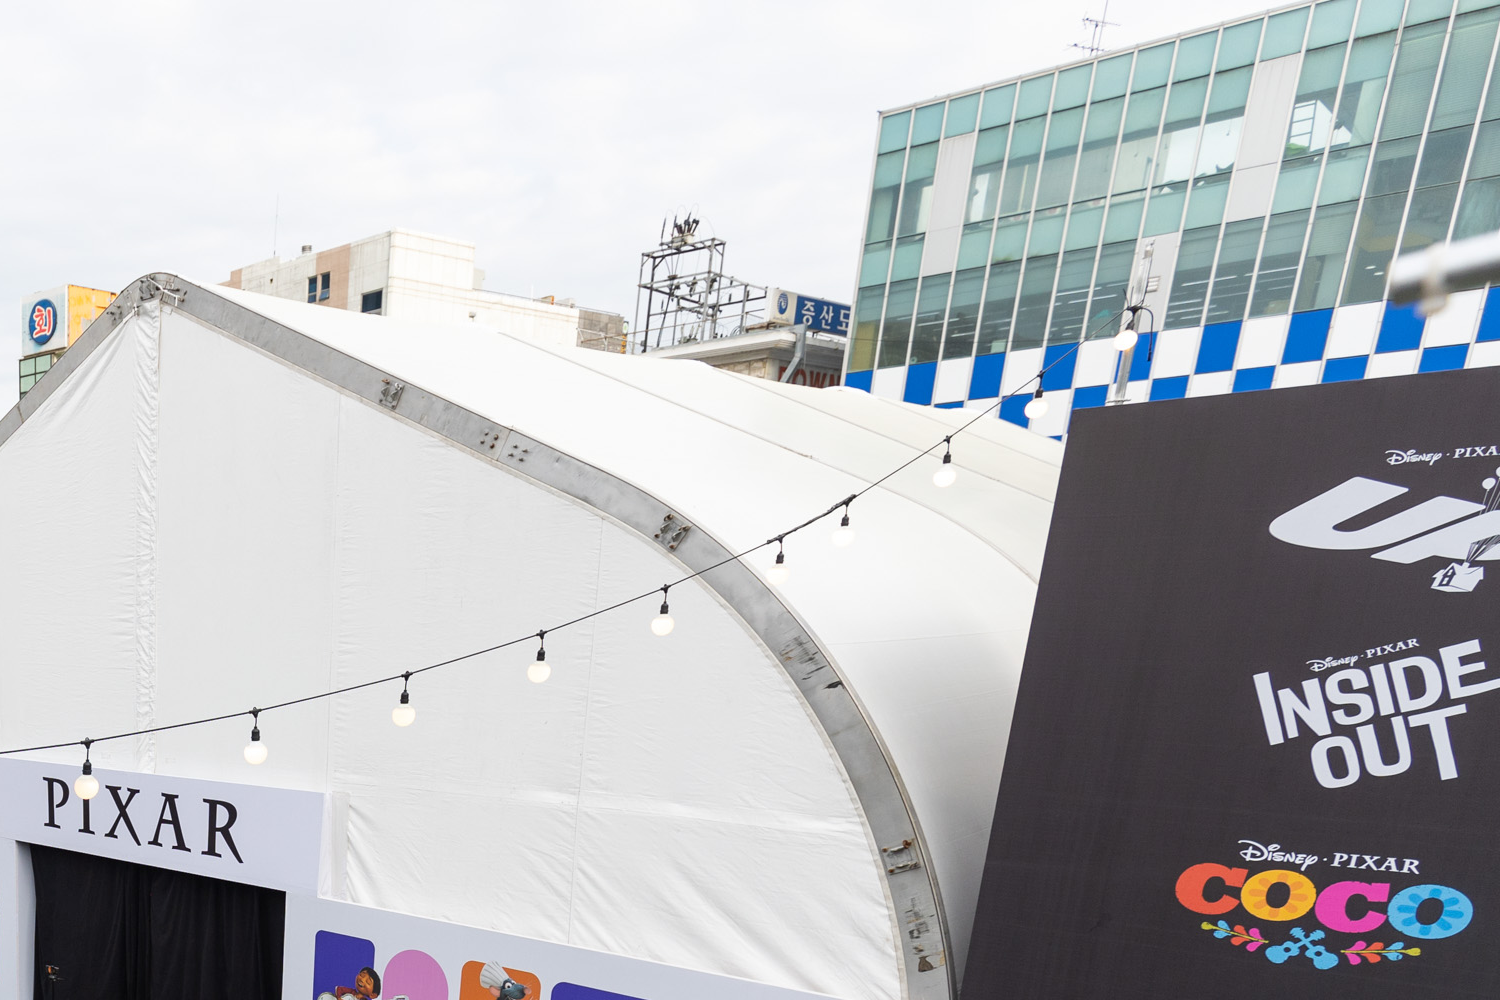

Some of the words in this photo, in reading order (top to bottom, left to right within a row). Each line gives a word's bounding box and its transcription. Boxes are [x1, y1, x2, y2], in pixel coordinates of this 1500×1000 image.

[32, 305, 52, 337] 회
[1385, 449, 1443, 466] Disney
[1453, 445, 1500, 459] PIXA
[1306, 656, 1359, 672] Disney
[1366, 638, 1420, 659] PIXAR
[1252, 638, 1500, 746] INSIDE
[1310, 703, 1468, 789] OUT
[42, 776, 244, 864] PIXAR
[1238, 839, 1318, 870] Disney
[1330, 852, 1421, 875] PIXAR
[1175, 862, 1474, 940] COCO
